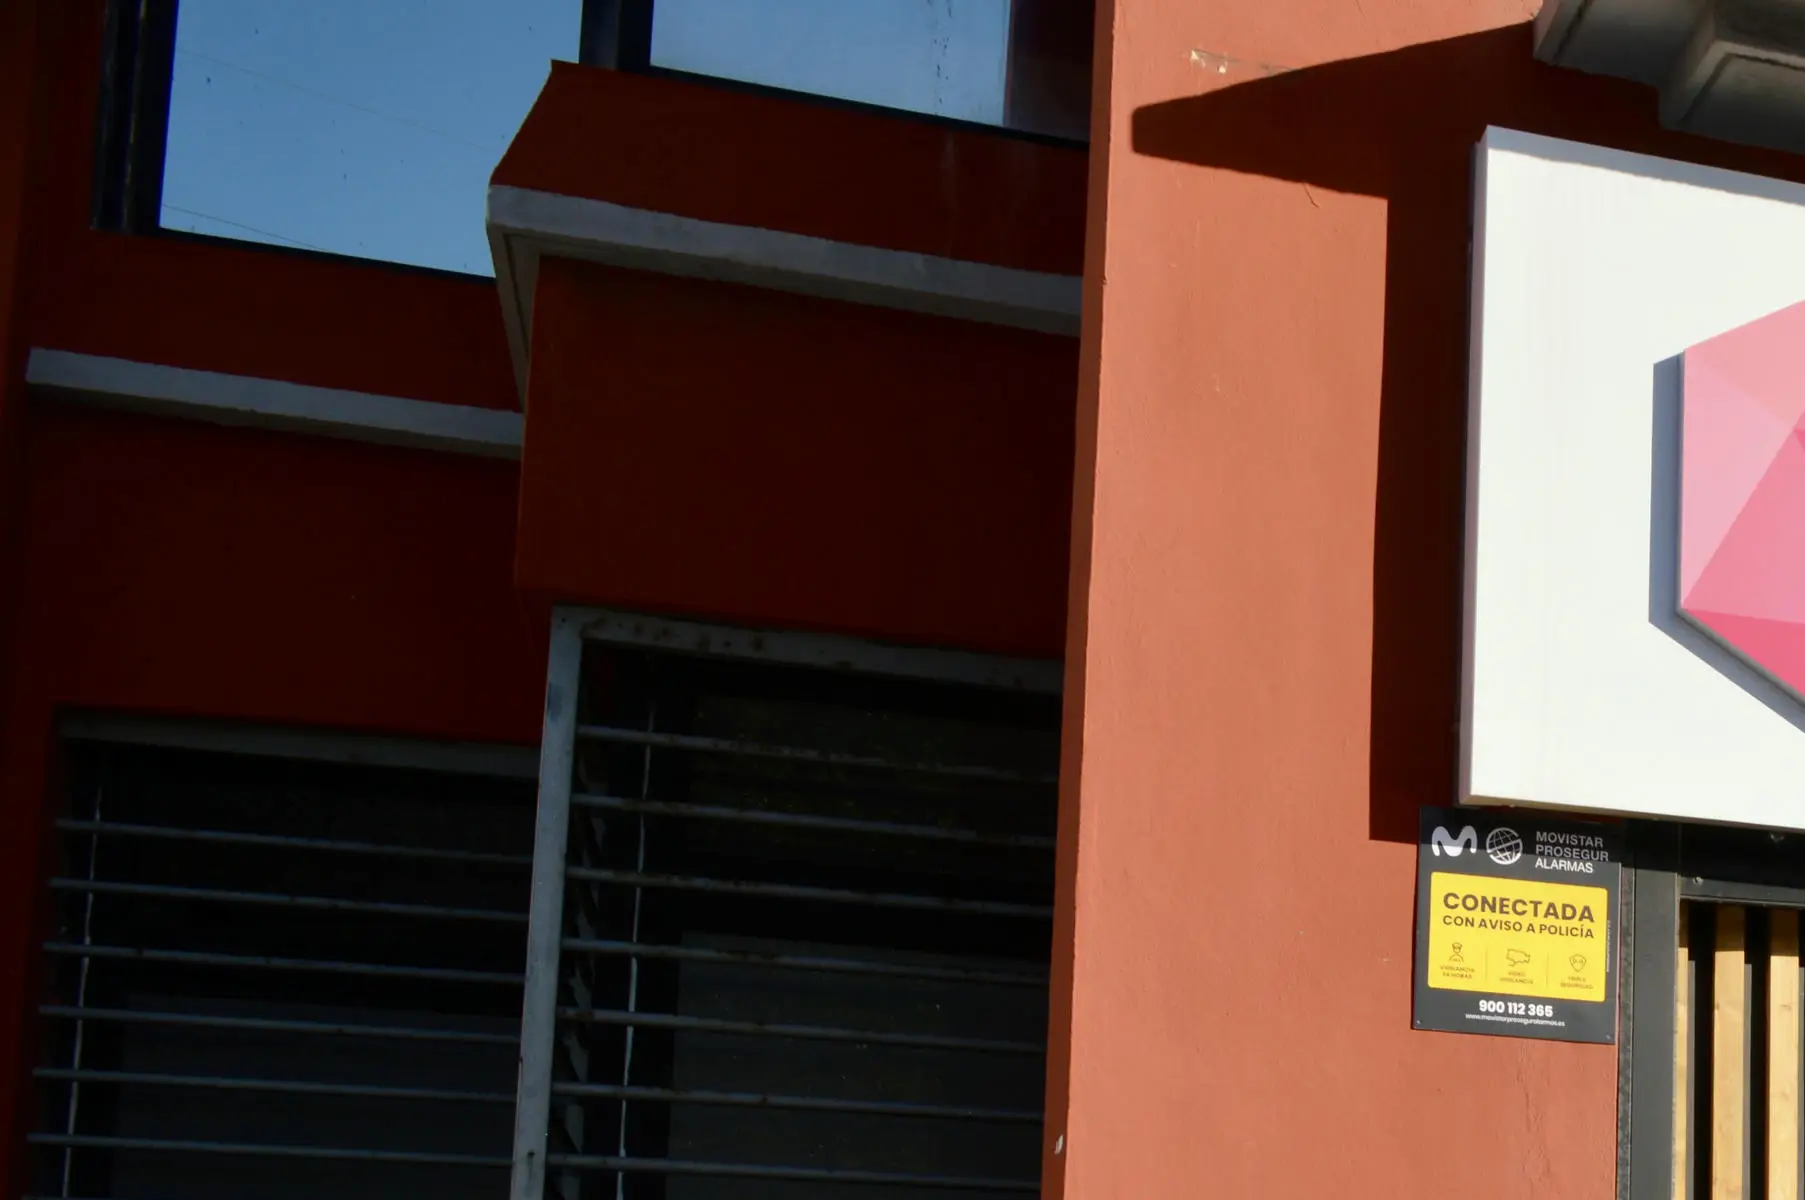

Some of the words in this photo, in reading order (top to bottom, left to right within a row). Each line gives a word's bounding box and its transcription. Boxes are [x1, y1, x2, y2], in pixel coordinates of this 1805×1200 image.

[1536, 831, 1604, 849] MOVISTAR
[1536, 844, 1609, 862] PROSEGUR
[1535, 859, 1594, 873] ALARMAS
[1443, 892, 1595, 923] CONECTADA
[1443, 915, 1475, 928] CON
[1478, 919, 1524, 932] AVISO
[1526, 924, 1536, 934] A
[1540, 924, 1594, 939] POLICÍA
[1479, 999, 1505, 1013] 900
[1507, 1002, 1526, 1015] 112
[1528, 1005, 1553, 1017] 365
